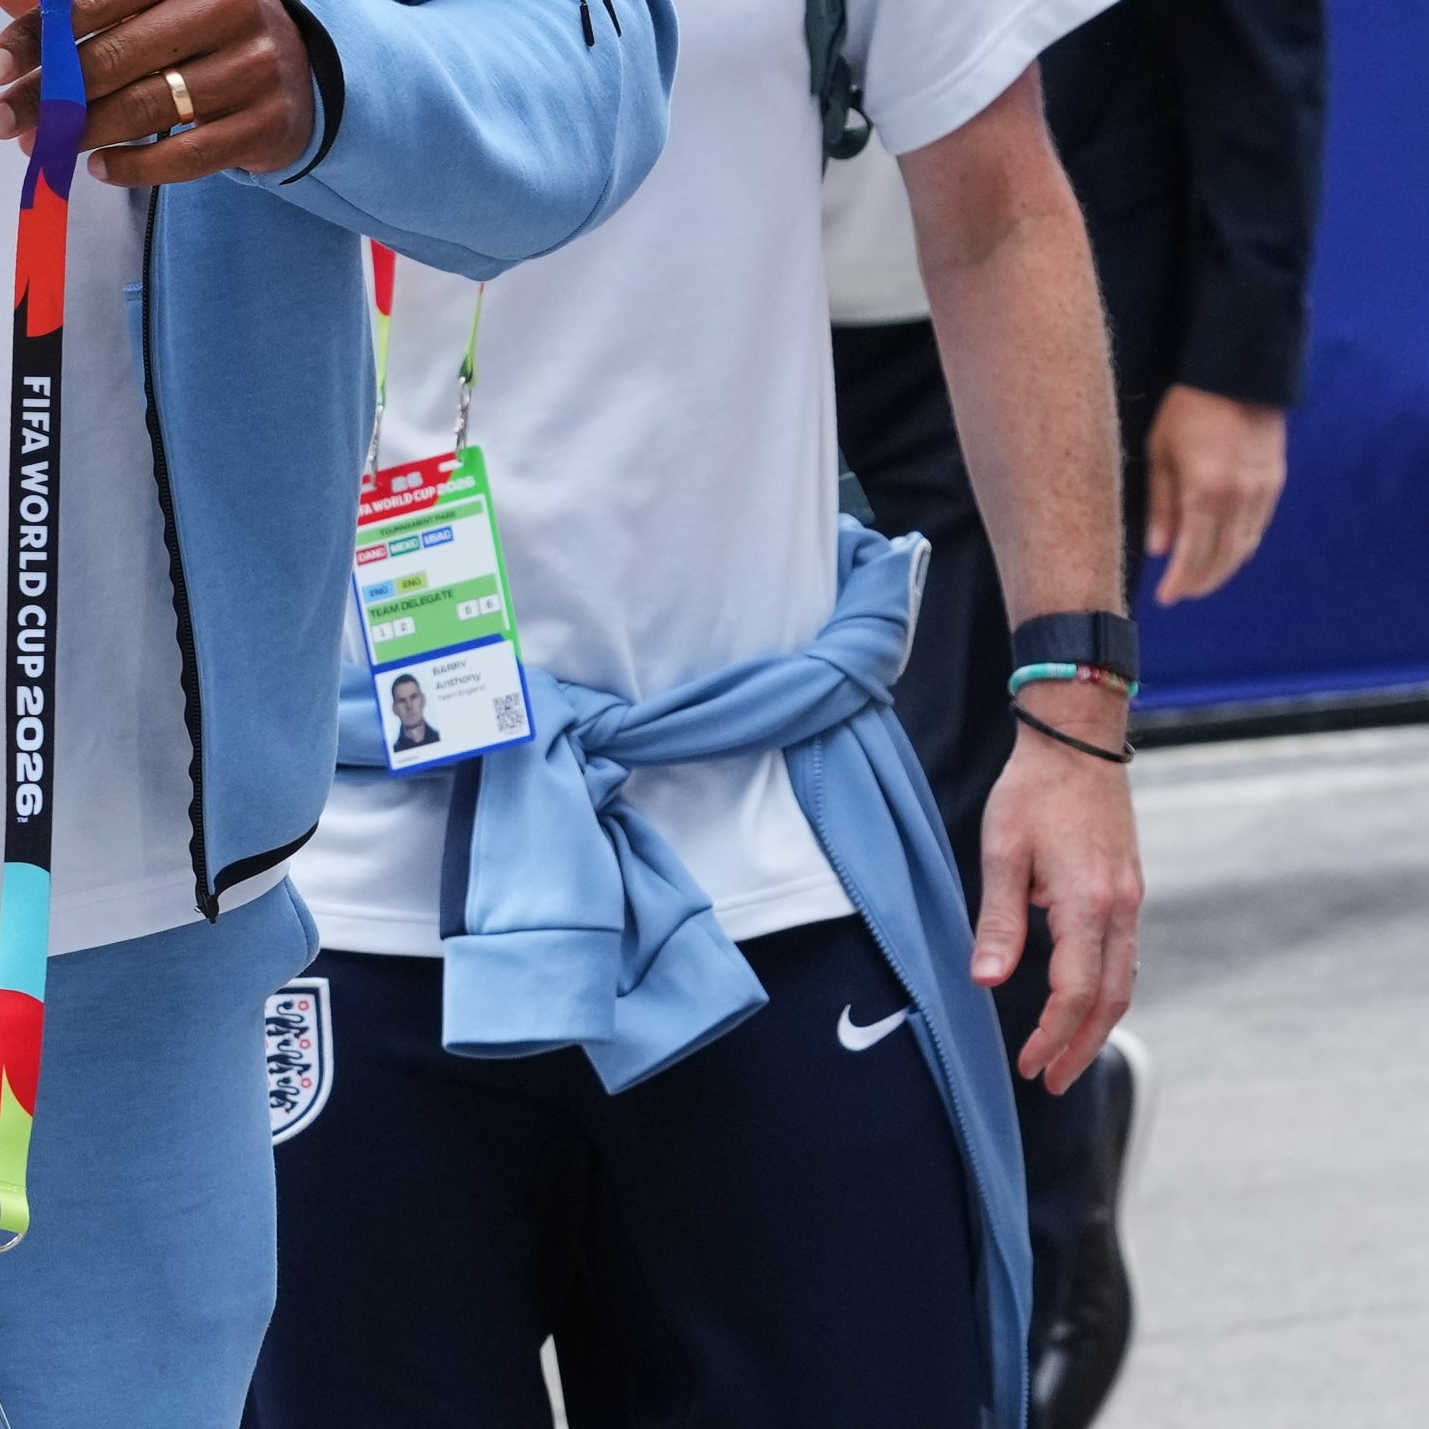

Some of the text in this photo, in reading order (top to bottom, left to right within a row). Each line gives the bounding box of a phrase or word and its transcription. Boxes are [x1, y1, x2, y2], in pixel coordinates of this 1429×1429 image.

[21, 376, 51, 454] FIFA
[18, 460, 49, 597] WORLD
[372, 493, 413, 511] WORLD
[413, 485, 436, 502] CUP
[370, 588, 454, 618] TEAM DELEGATE
[16, 604, 47, 678] CUP
